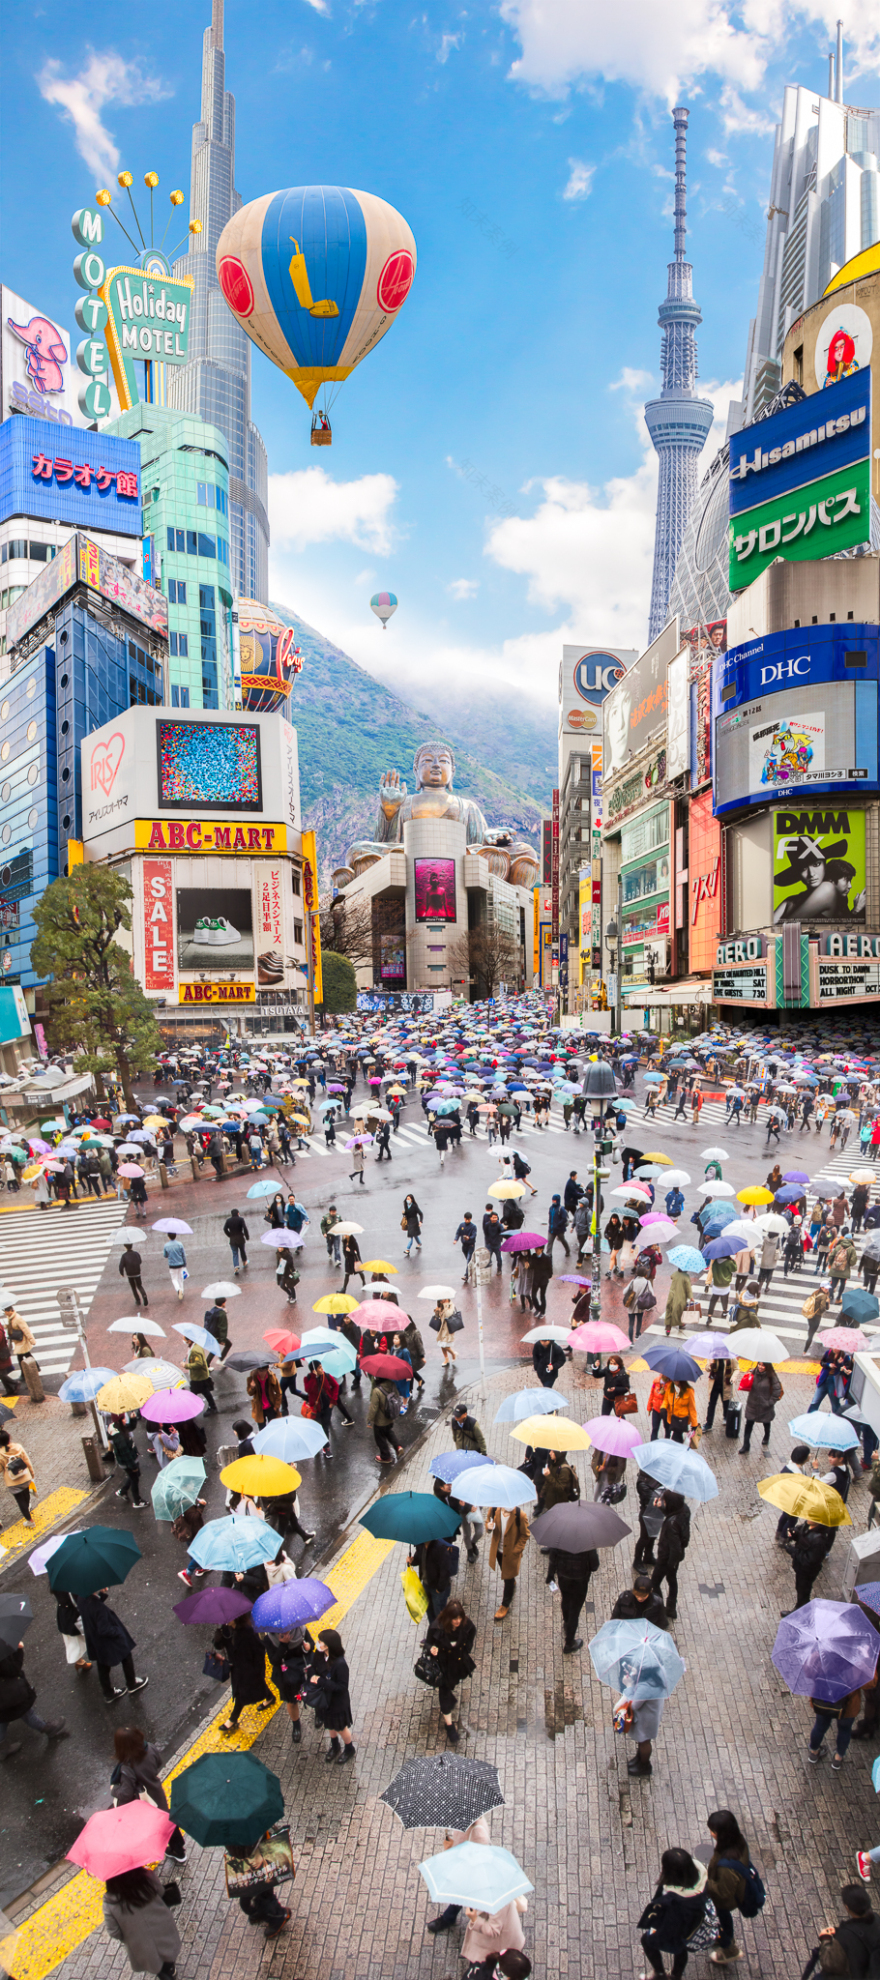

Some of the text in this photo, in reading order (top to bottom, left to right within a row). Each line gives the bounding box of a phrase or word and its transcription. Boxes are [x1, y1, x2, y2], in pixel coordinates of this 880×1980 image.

[82, 211, 105, 414] MOTEL
[116, 276, 187, 333] Holiday
[121, 323, 185, 357] MOTEL
[729, 406, 866, 480] Hisamitsu
[32, 453, 138, 497] カラオケ館
[733, 487, 860, 561] サロンパス
[719, 643, 764, 673] DHC Channel
[760, 655, 811, 686] DHC
[90, 752, 114, 791] IRIS
[778, 788, 793, 797] DHC
[89, 794, 129, 824] アイリスオーヤマ
[776, 812, 851, 834] DMM
[148, 822, 274, 848] ABC-MART
[776, 836, 826, 859] FX
[262, 882, 272, 932] 2足目半額
[271, 870, 282, 944] ビジネスシューズ
[150, 876, 168, 972] SALE
[716, 938, 760, 965] AERO
[732, 969, 753, 978] HAUNTED
[754, 968, 765, 976] HILL
[753, 979, 765, 987] SAT
[820, 966, 839, 974] DUSK
[842, 966, 850, 974] TO
[820, 976, 864, 986] HORRORTHON
[184, 986, 251, 1001] ABC-MART
[724, 988, 742, 997] GUESTS
[753, 990, 765, 998] 730
[820, 988, 834, 997] ALL
[836, 986, 856, 996] NIGHT
[262, 1006, 304, 1016] TSUTAYA
